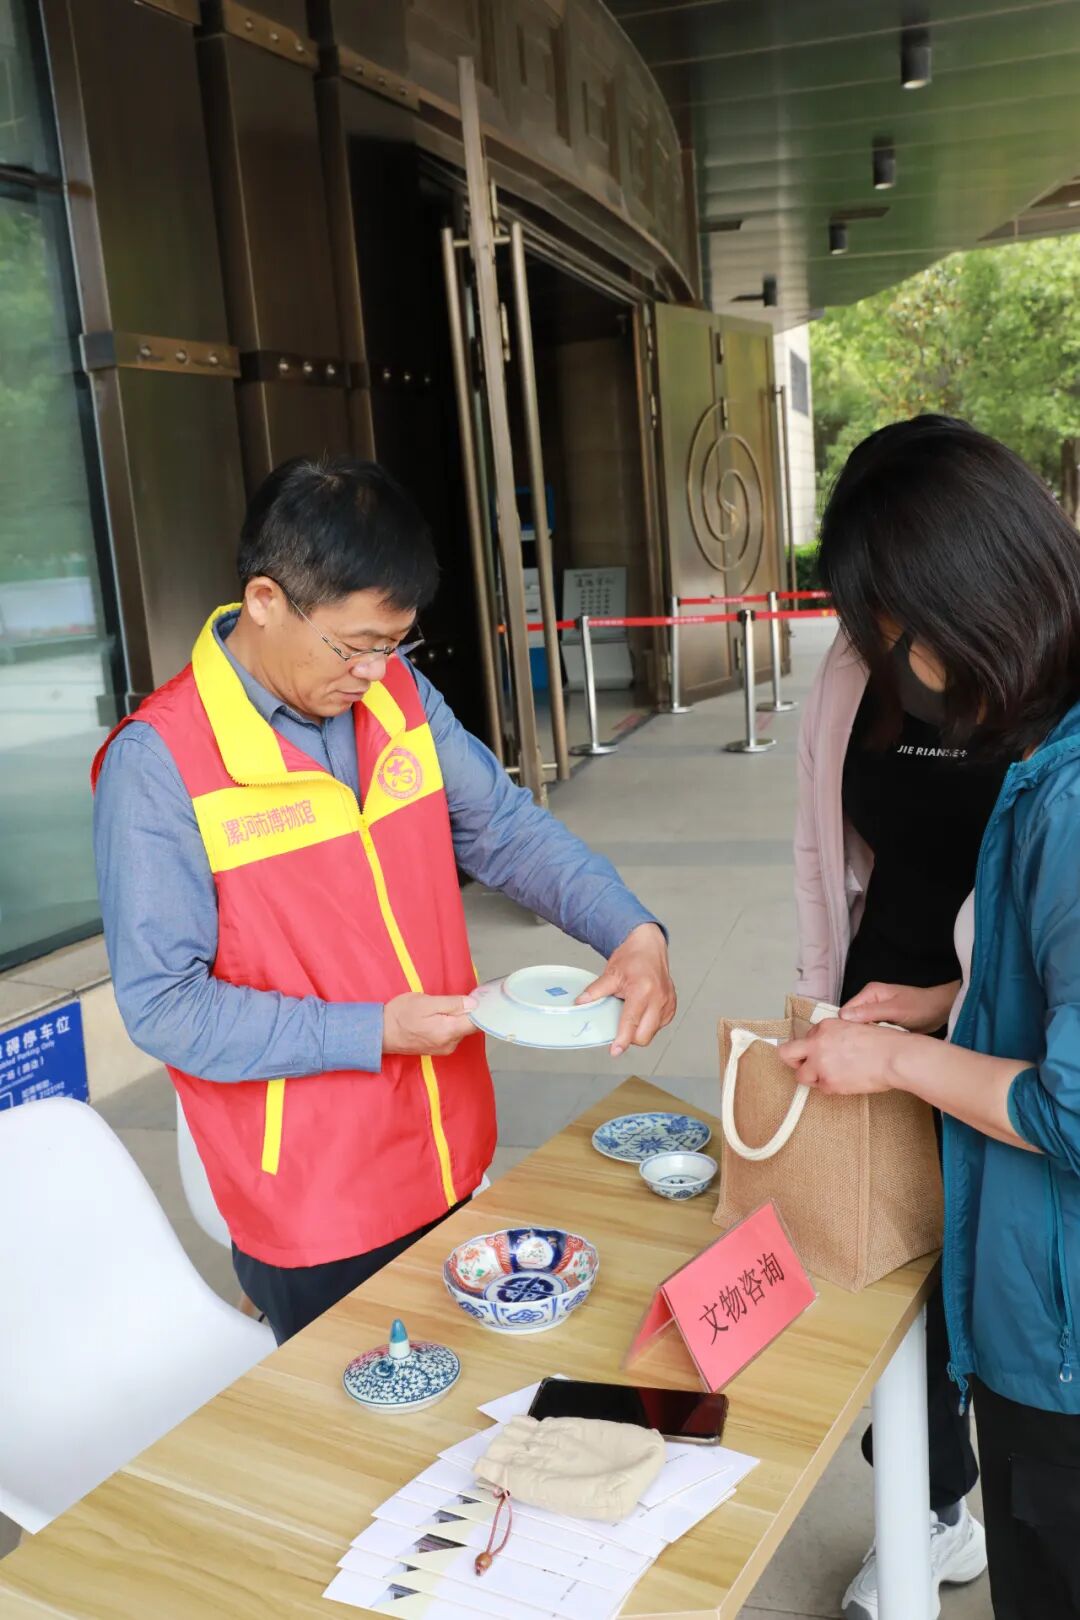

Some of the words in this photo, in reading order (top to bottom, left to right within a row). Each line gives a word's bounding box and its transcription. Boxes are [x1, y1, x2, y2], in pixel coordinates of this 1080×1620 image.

[897, 745, 915, 755] JIE
[221, 799, 316, 847] 漯河市博物馆
[698, 1252, 785, 1346] 文物咨询
